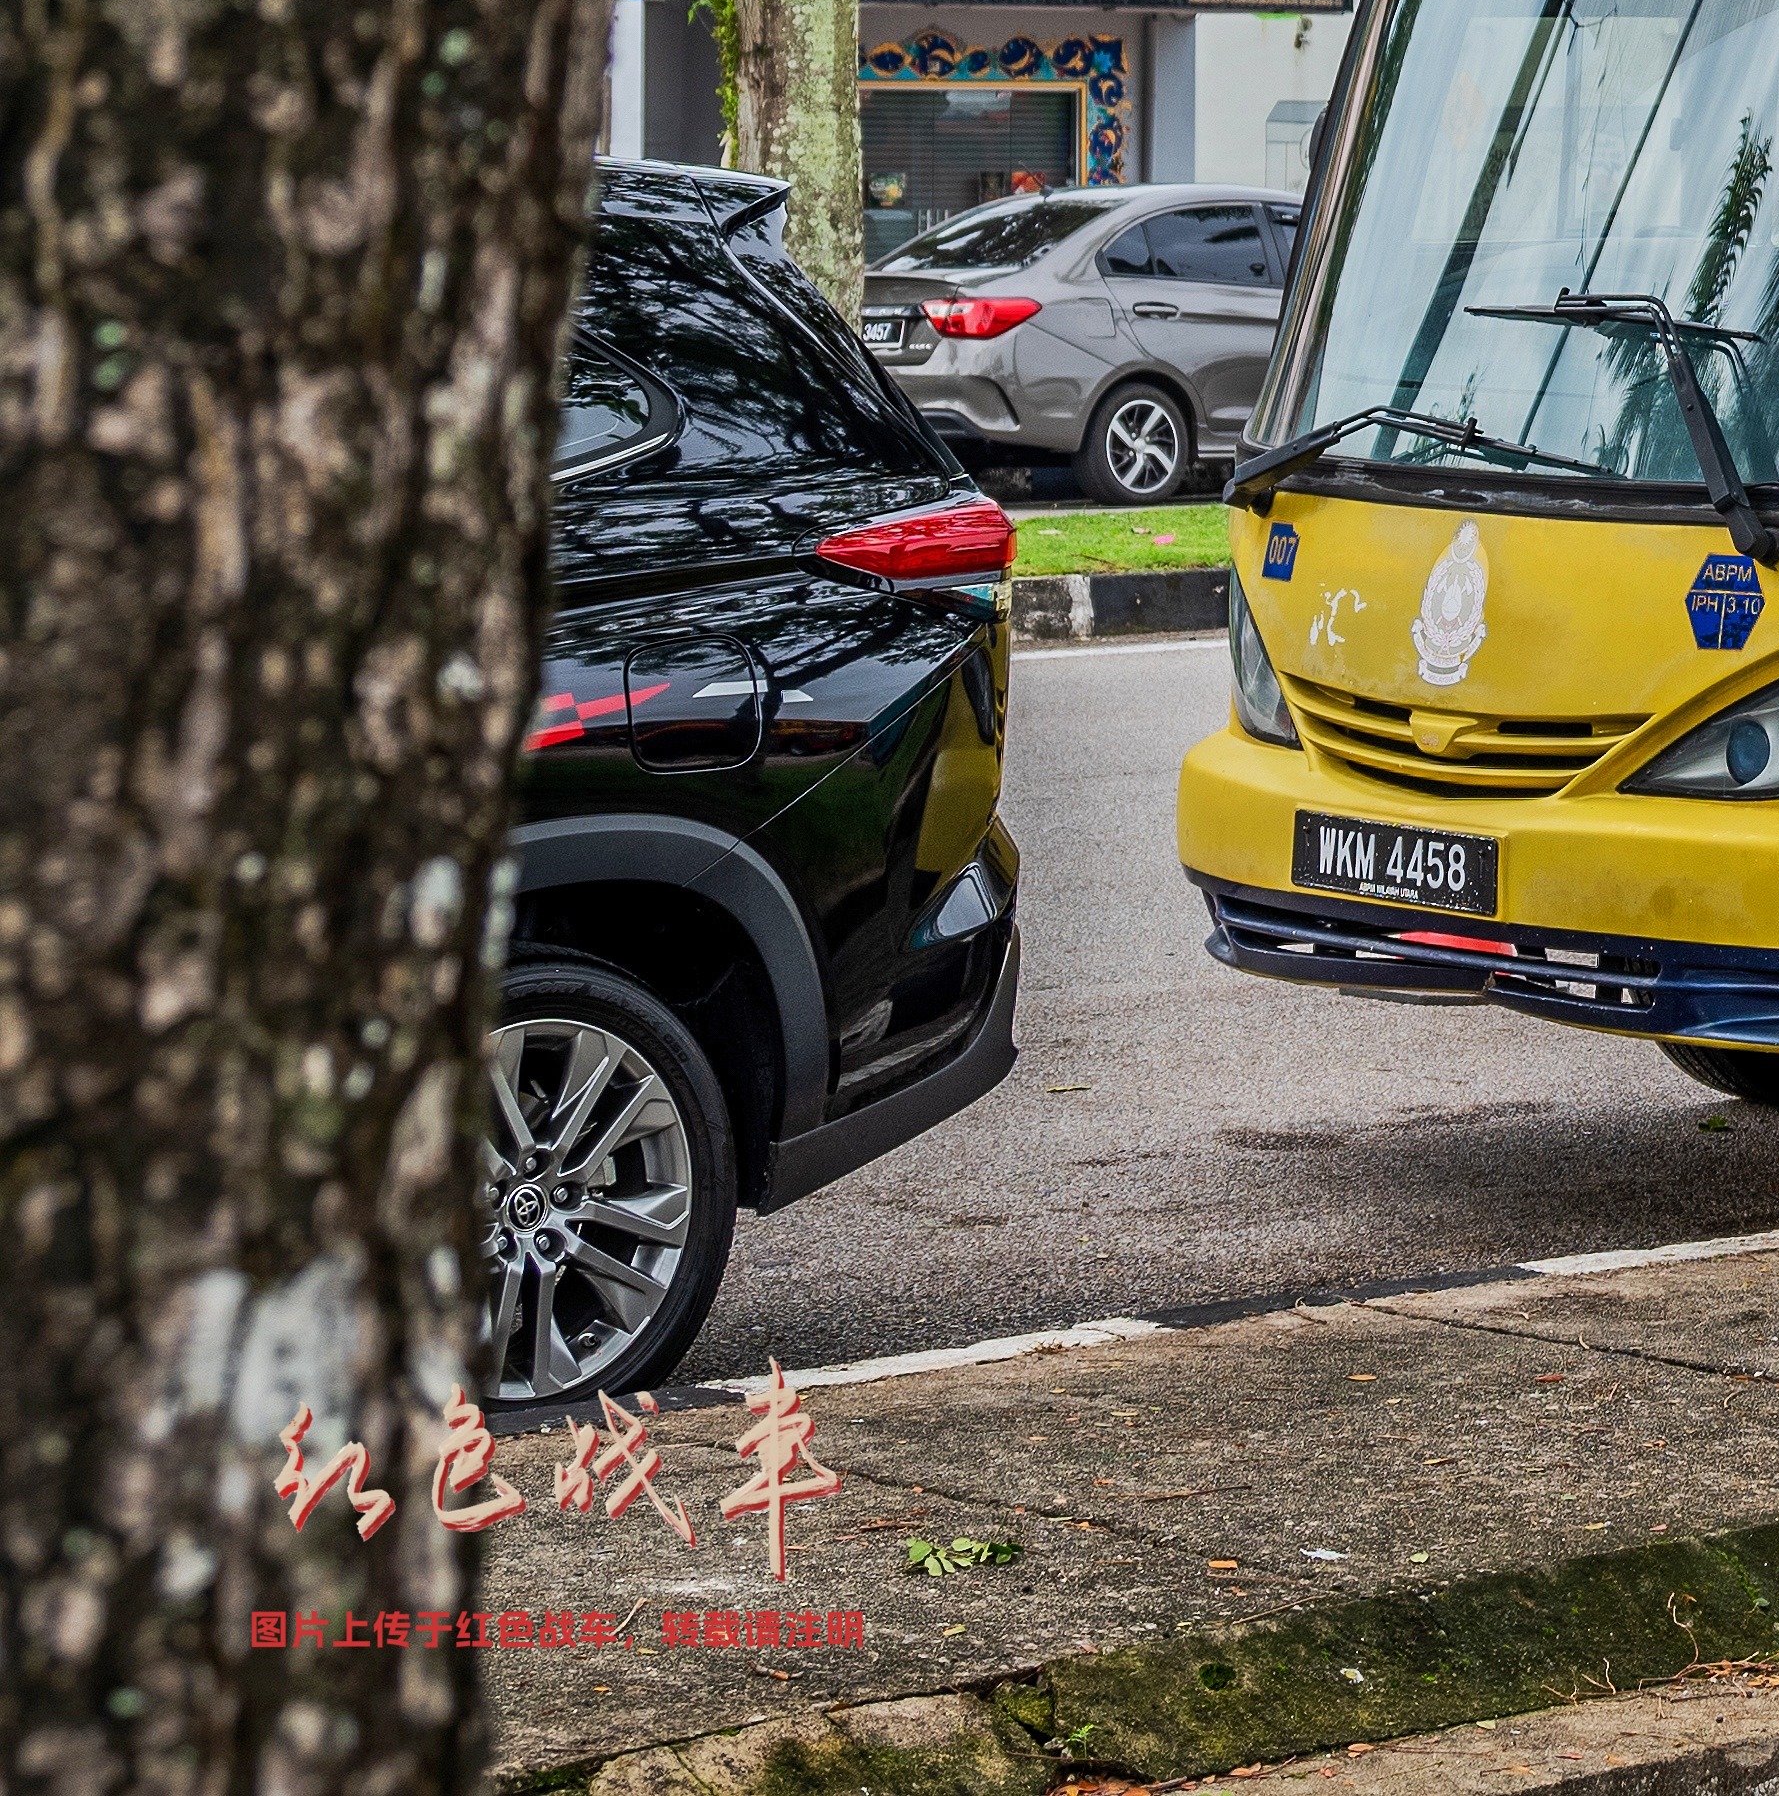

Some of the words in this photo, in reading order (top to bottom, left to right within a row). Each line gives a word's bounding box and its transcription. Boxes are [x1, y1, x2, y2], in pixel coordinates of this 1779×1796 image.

[1268, 534, 1297, 566] 007
[1702, 564, 1753, 582] ABPM
[1726, 596, 1762, 615] 3.10
[1318, 825, 1376, 881] WKM
[1386, 835, 1467, 892] 4458
